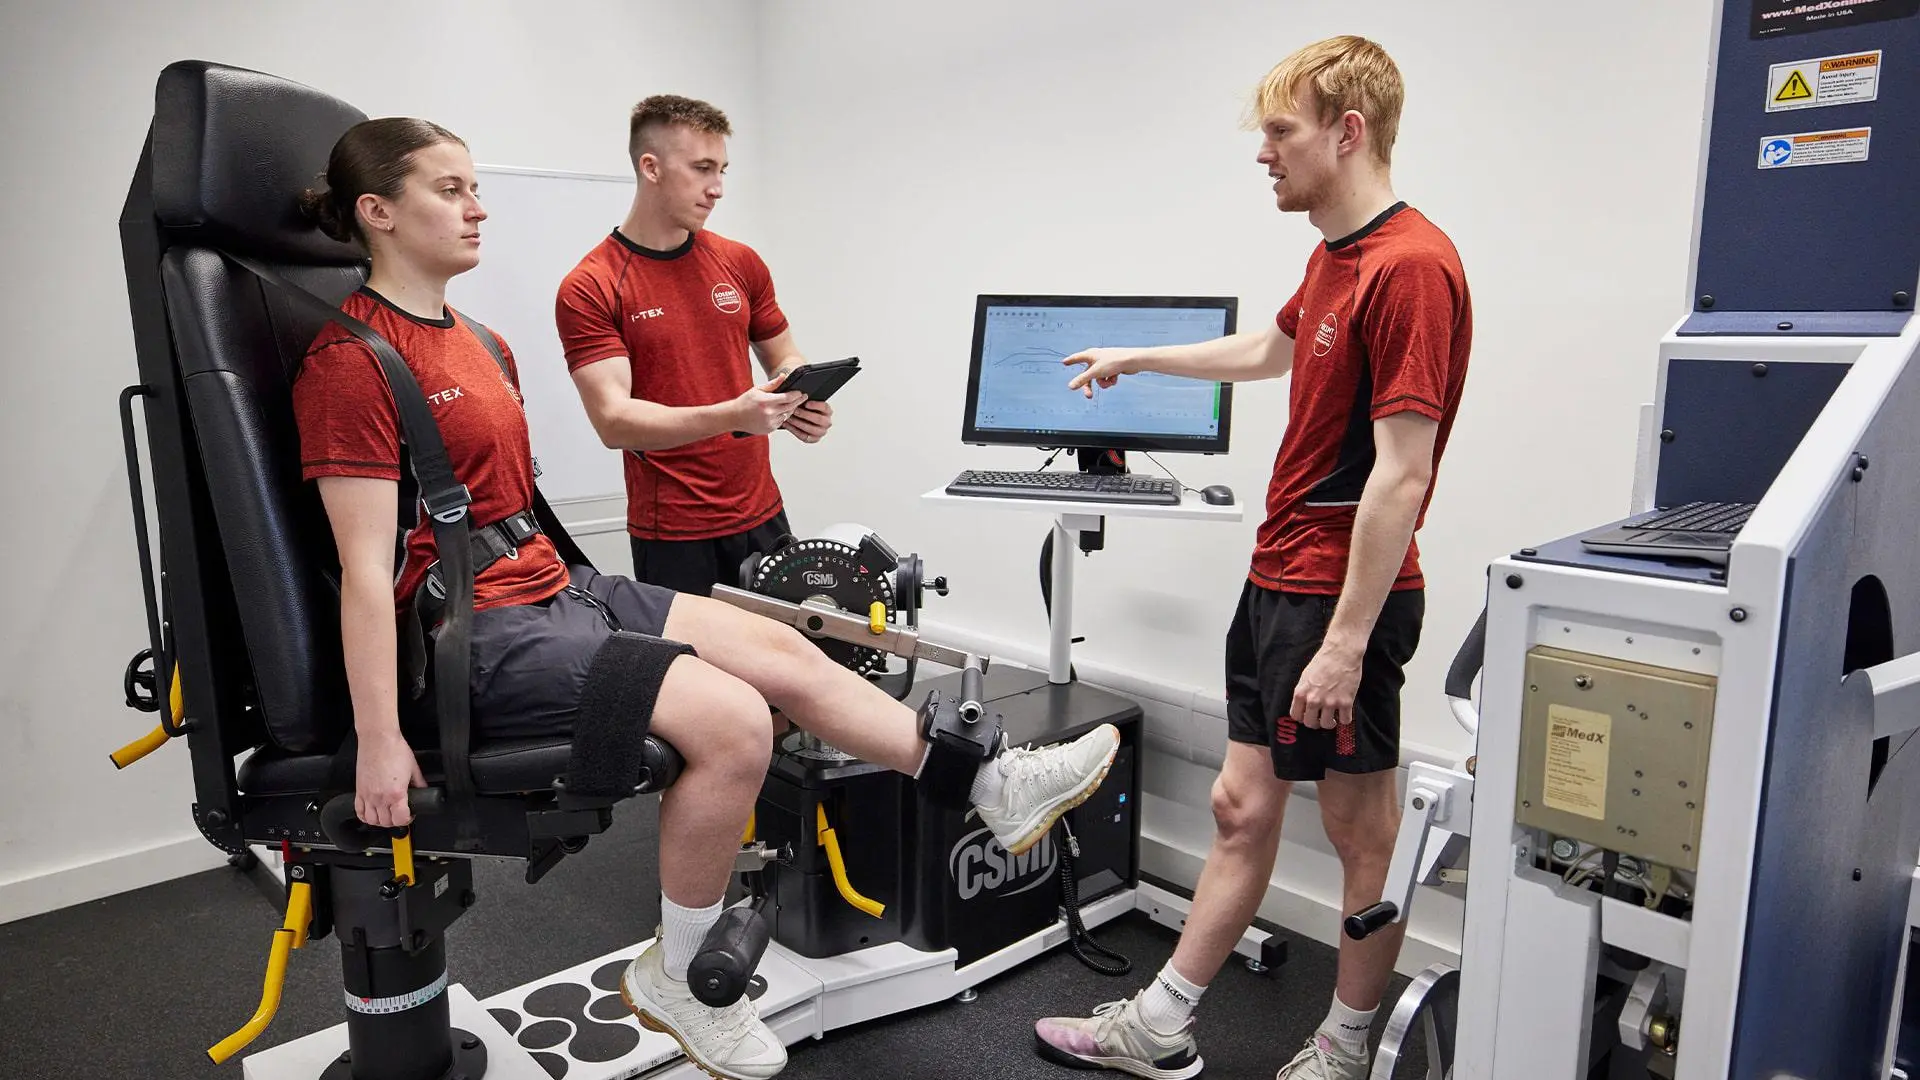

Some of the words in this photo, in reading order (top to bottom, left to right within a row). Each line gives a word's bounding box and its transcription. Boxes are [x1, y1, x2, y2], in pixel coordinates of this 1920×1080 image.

[1836, 8, 1853, 16] USA
[1831, 56, 1876, 68] WARNING
[806, 573, 833, 585] CSMi
[1566, 727, 1606, 744] MedX
[1158, 976, 1190, 1005] didas
[1340, 1023, 1368, 1031] adid
